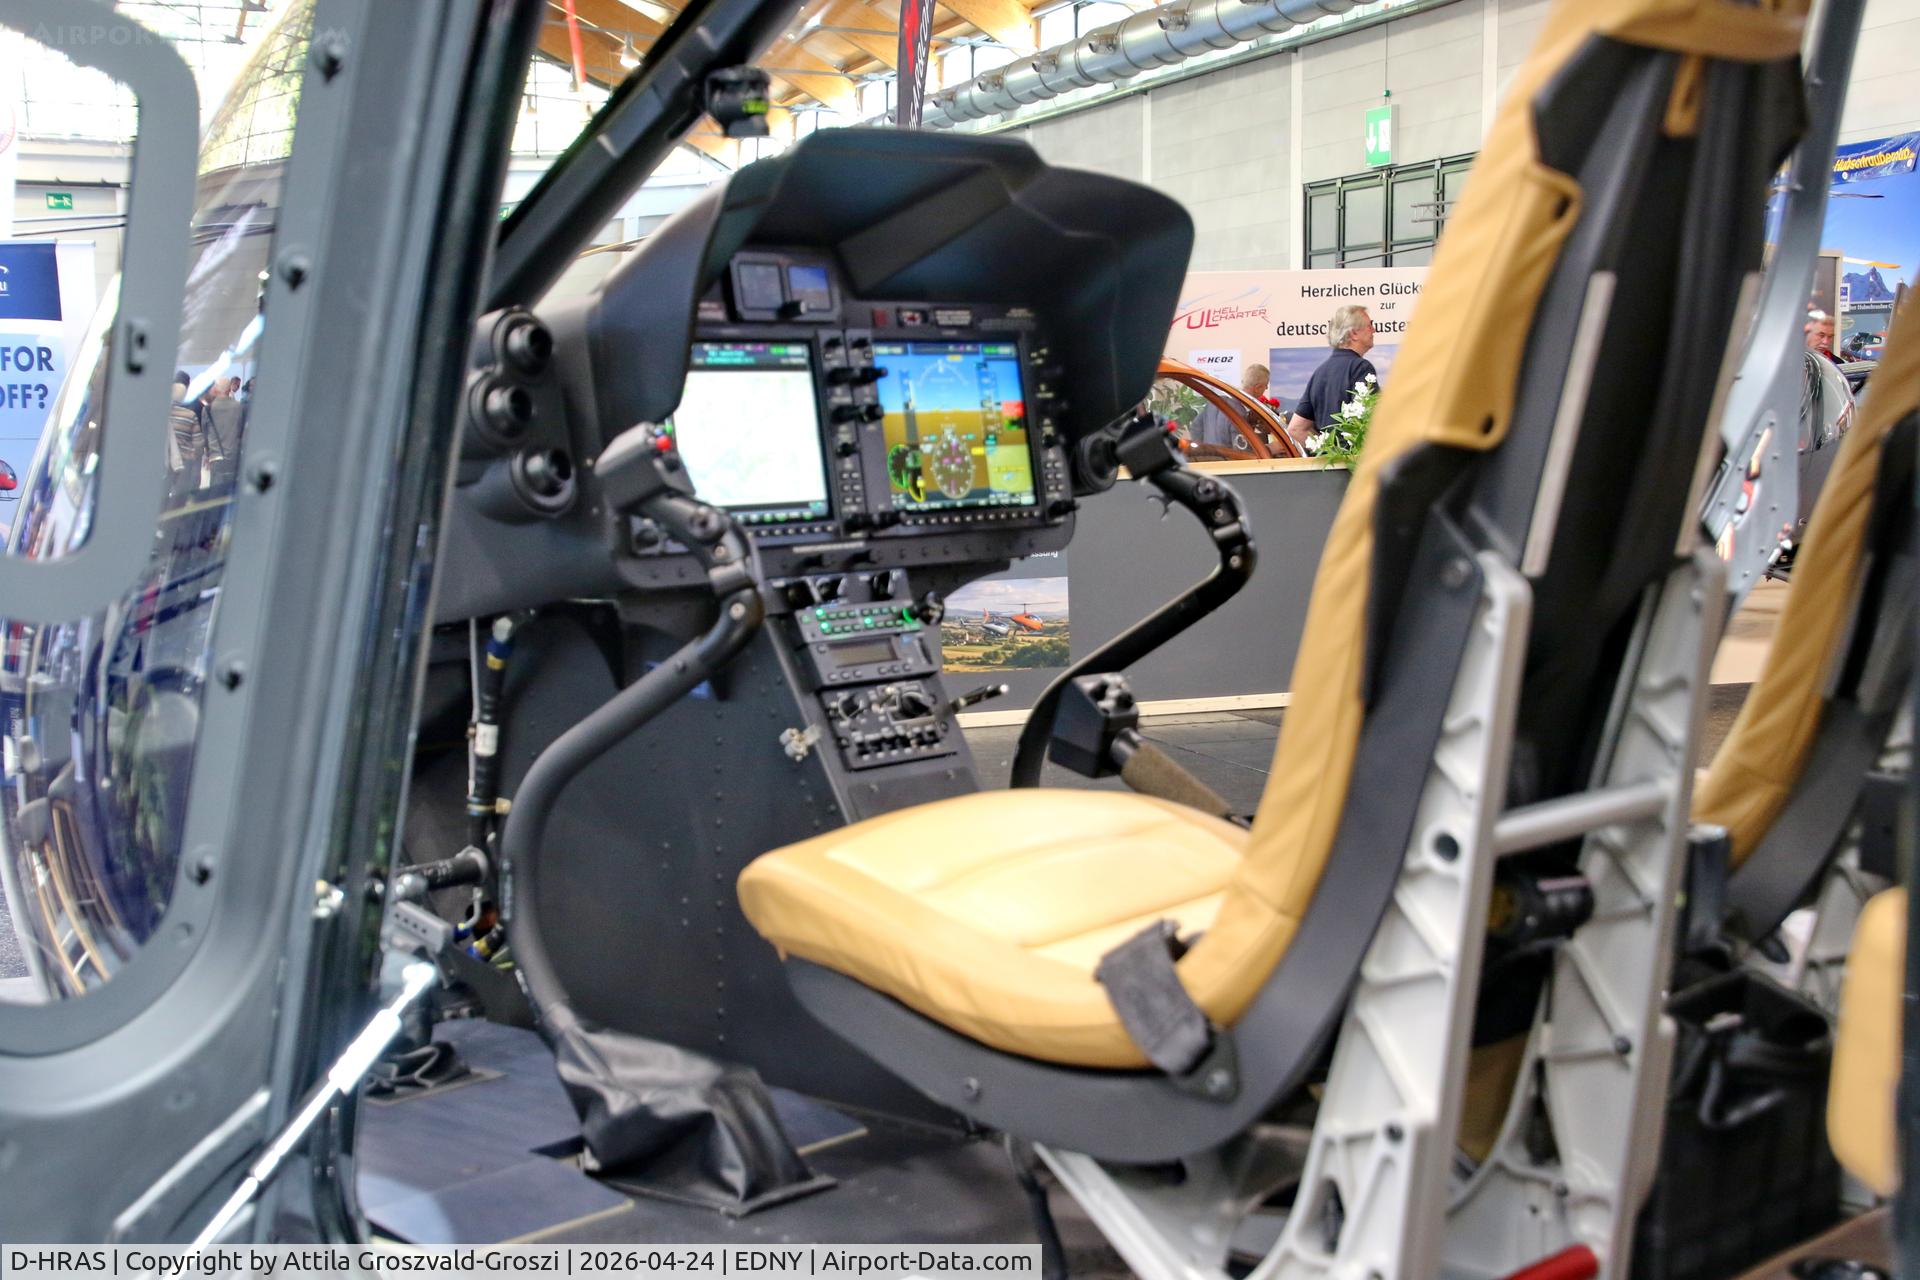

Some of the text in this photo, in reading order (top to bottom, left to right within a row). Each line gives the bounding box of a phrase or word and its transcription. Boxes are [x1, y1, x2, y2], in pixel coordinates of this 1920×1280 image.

[1301, 282, 1424, 298] Herzlichen Glück
[1213, 306, 1239, 315] HELI
[1380, 302, 1396, 310] zur
[1187, 309, 1219, 329] UL
[1212, 309, 1267, 322] CHARTER
[1276, 321, 1331, 336] deutsc
[0, 346, 54, 372] FOR
[0, 383, 48, 409] FF?
